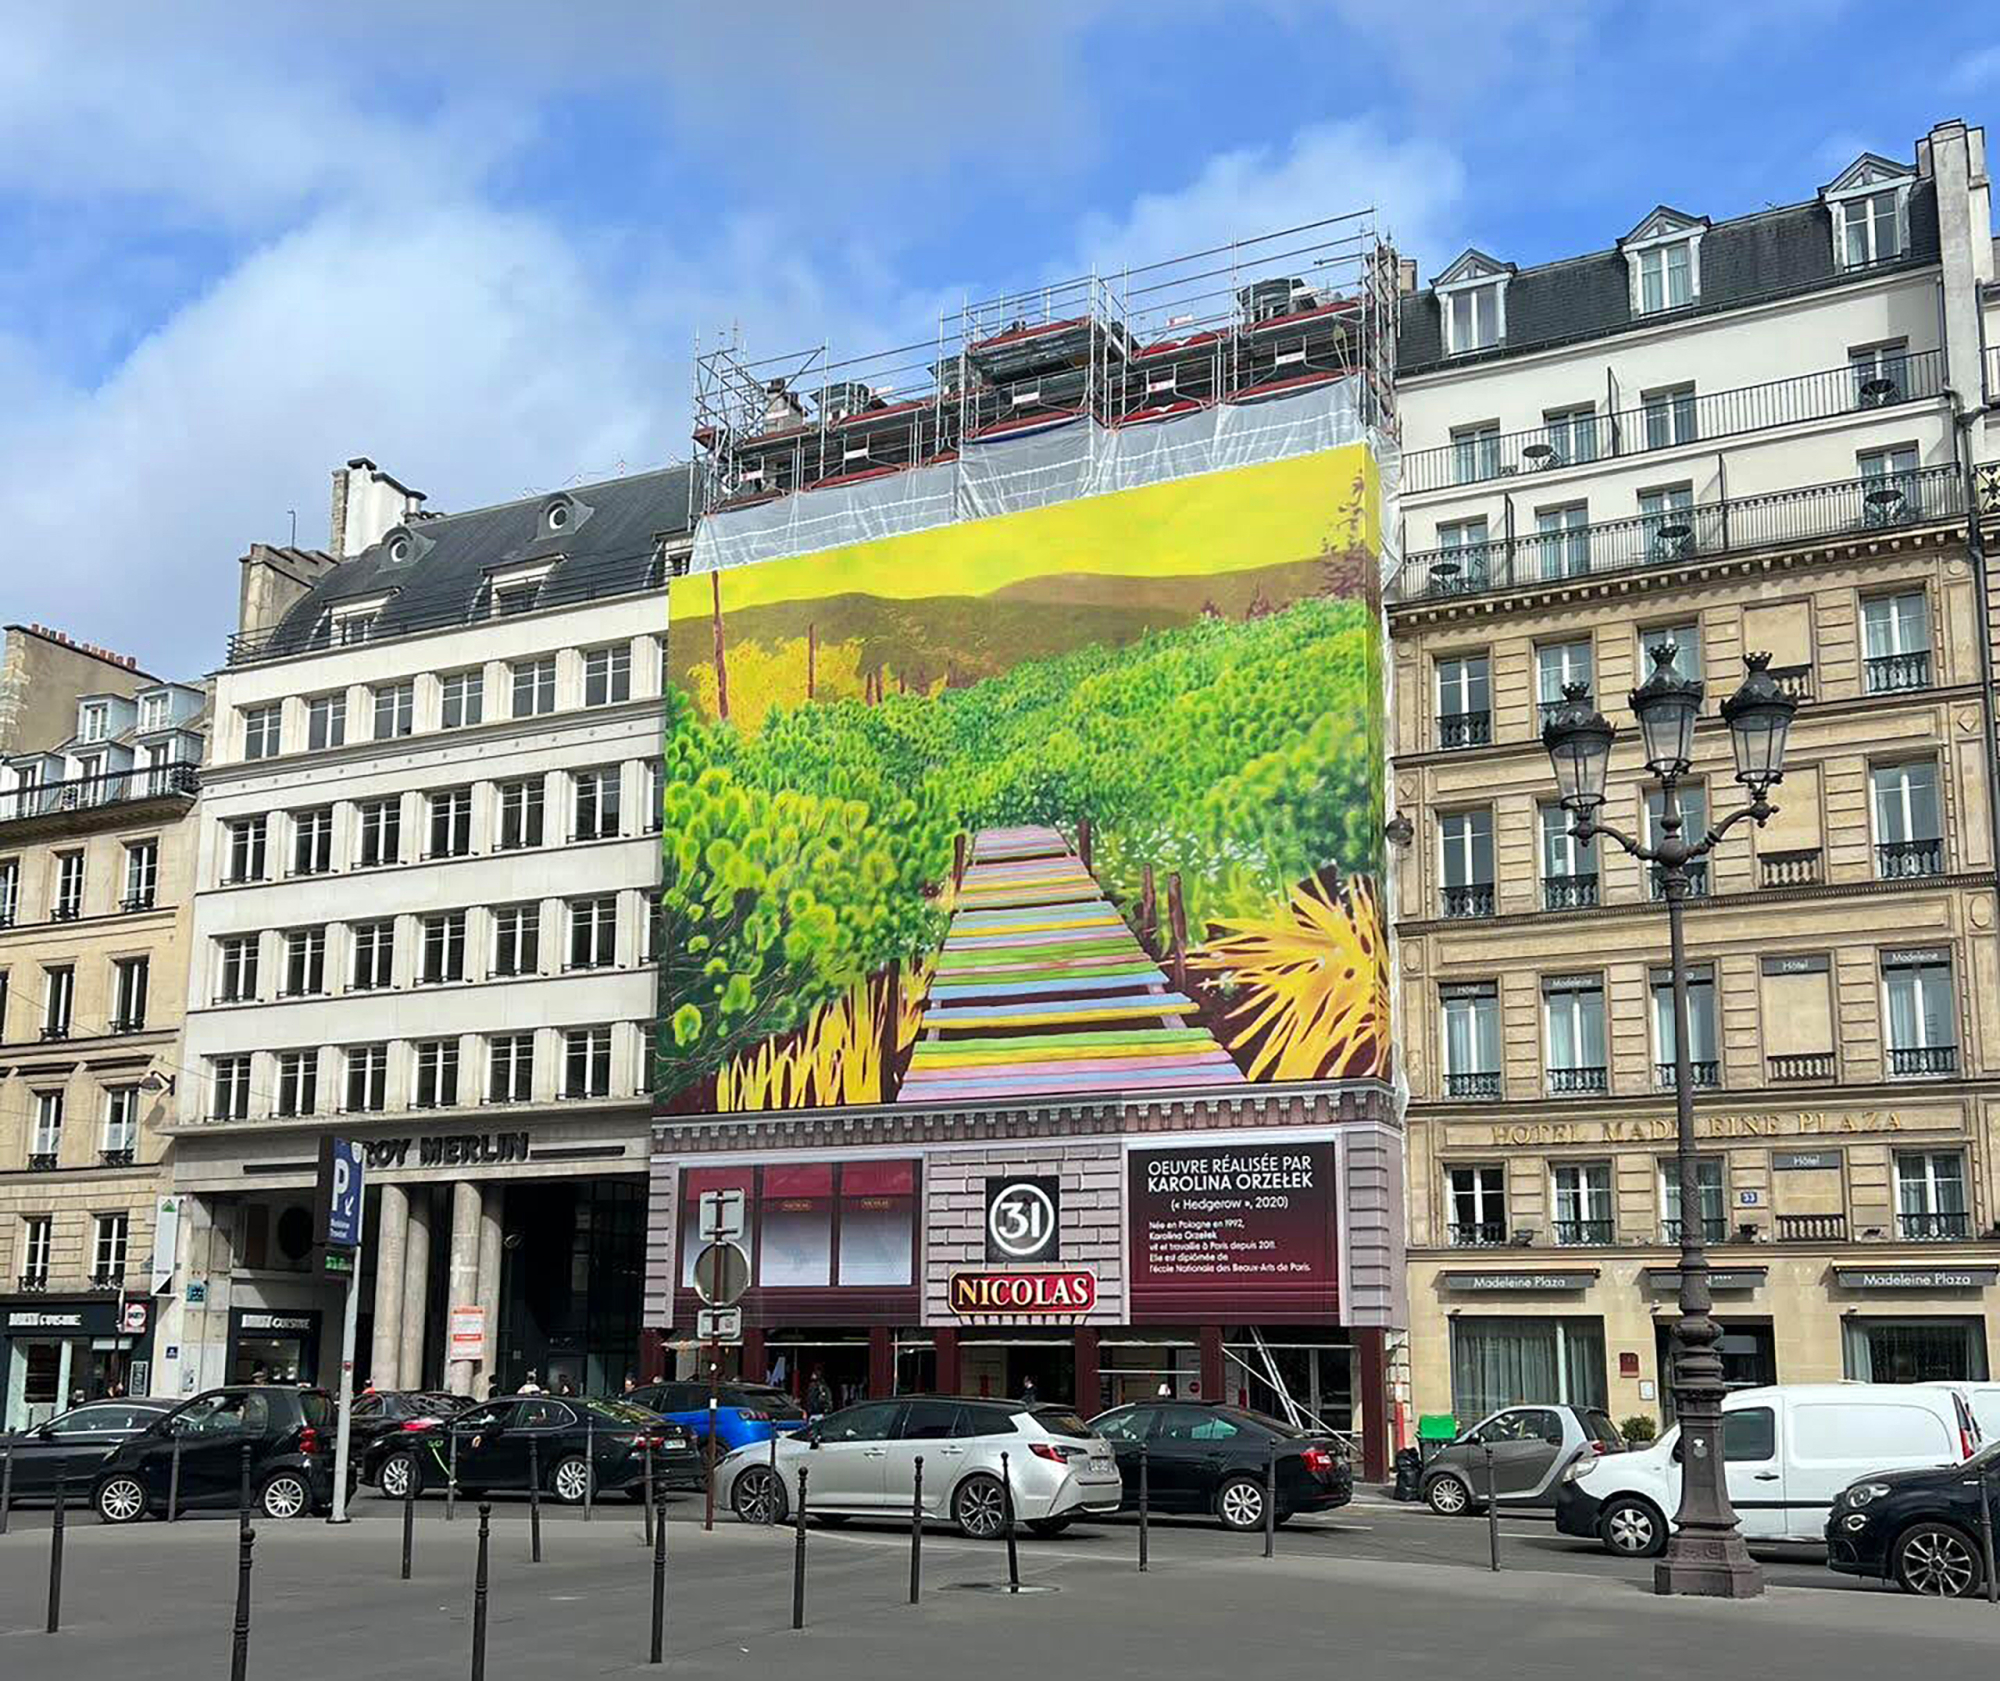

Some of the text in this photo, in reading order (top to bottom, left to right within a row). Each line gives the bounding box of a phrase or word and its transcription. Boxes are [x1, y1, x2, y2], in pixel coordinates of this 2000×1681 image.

[1892, 952, 1938, 963] Madeleine
[1491, 1111, 1903, 1146] HOTEL MADEINE PLAZA
[363, 1132, 530, 1168] ROY MERLIN
[1148, 1153, 1312, 1176] OEUVRE RÉALISÉE PAR
[1793, 1154, 1821, 1167] Hôtel
[331, 1158, 349, 1211] P
[1148, 1171, 1314, 1193] KAROLINA ORZEŁEK
[1183, 1198, 1242, 1212] Hedgerow
[1255, 1196, 1289, 1210] 2020)
[998, 1202, 1041, 1239] 31
[1166, 1221, 1178, 1230] en
[1178, 1219, 1212, 1232] Pologne
[1213, 1219, 1224, 1229] en
[1149, 1231, 1183, 1241] Karolina
[1209, 1240, 1229, 1250] Paris
[1230, 1239, 1257, 1252] depuis
[1216, 1252, 1229, 1262] de
[1175, 1263, 1215, 1273] Nationale
[1216, 1262, 1231, 1273] des
[1232, 1261, 1276, 1273] Beaux-Arts
[1277, 1261, 1288, 1272] de
[1474, 1275, 1566, 1289] Madeleine Plaza
[1863, 1272, 1971, 1286] Madeleine Plaza
[958, 1277, 1089, 1306] NICOLAS
